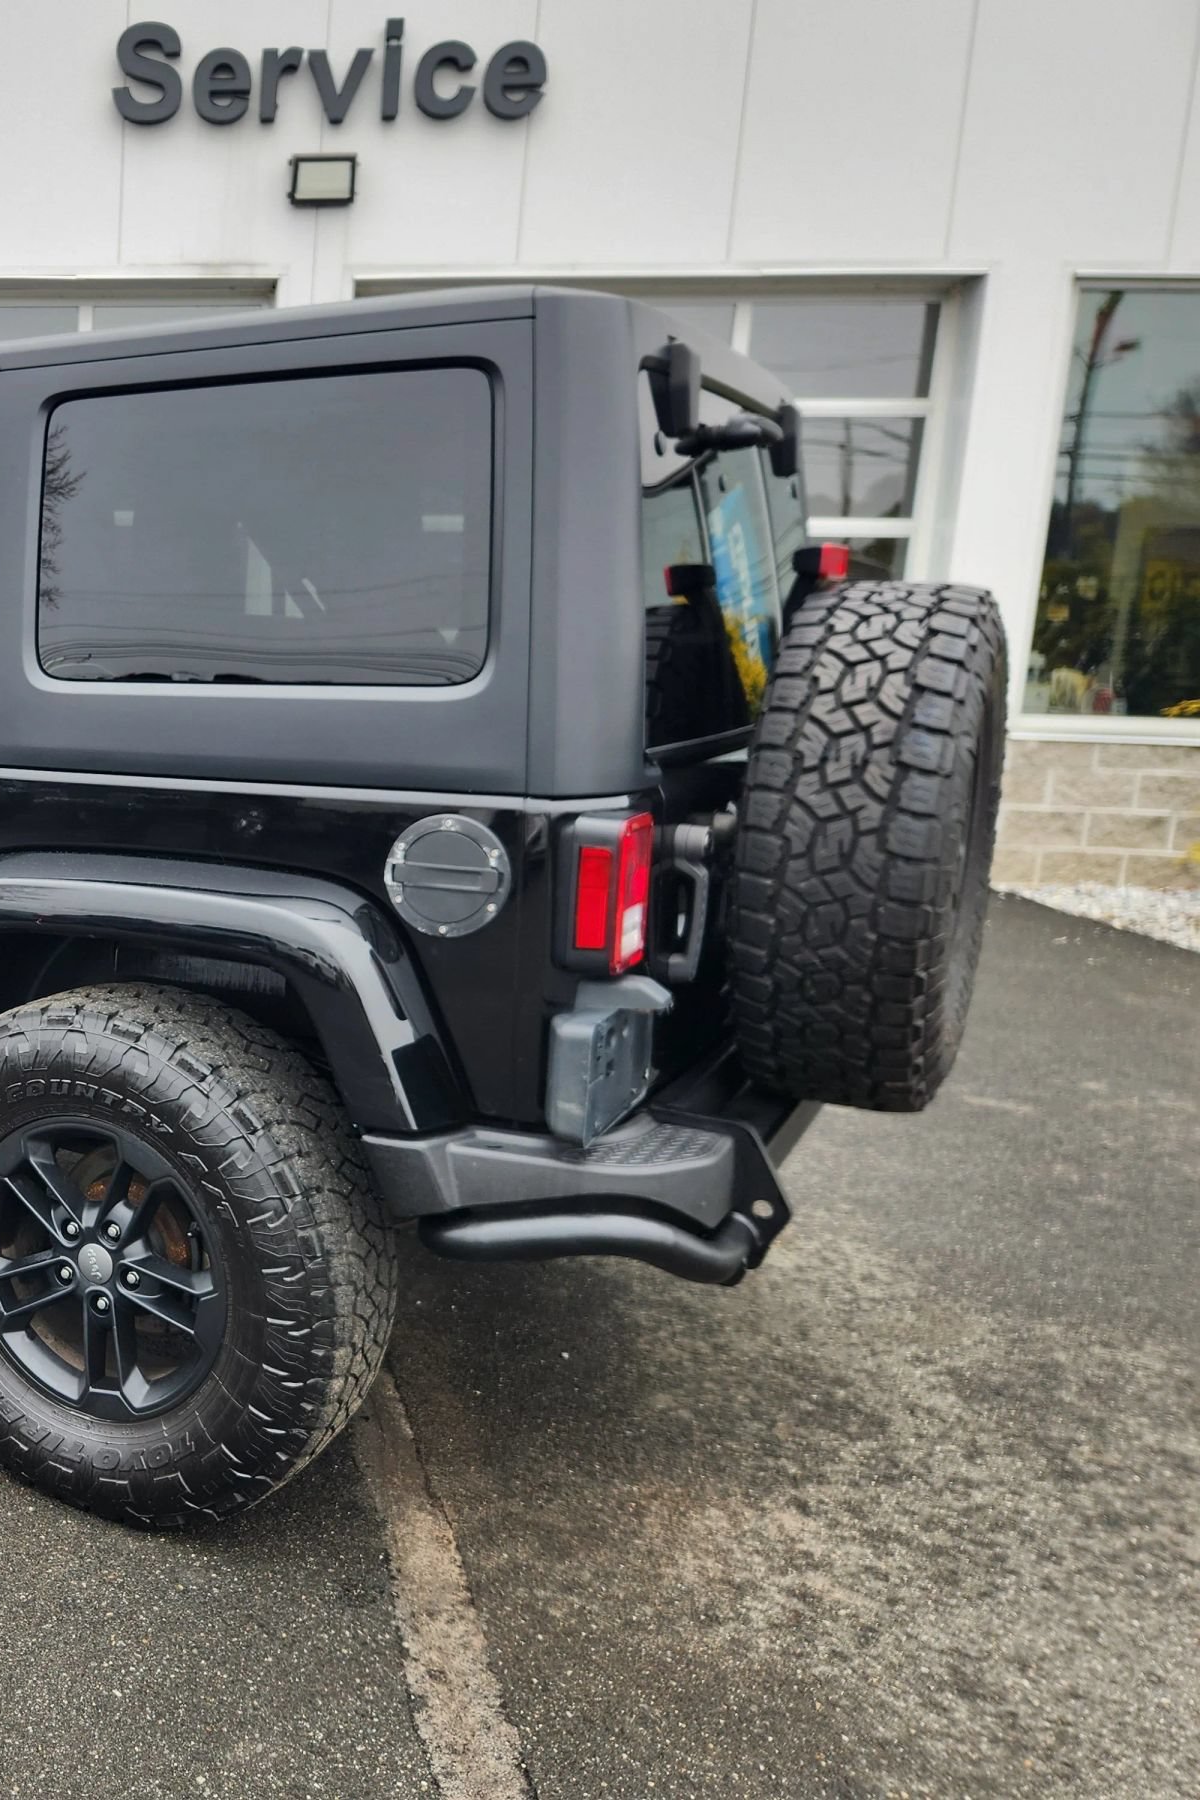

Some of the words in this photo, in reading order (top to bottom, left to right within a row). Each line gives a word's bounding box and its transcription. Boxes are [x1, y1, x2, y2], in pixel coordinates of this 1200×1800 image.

[111, 16, 548, 126] Service
[4, 1079, 175, 1134] COUNTRY
[92, 1431, 196, 1472] TOYO
